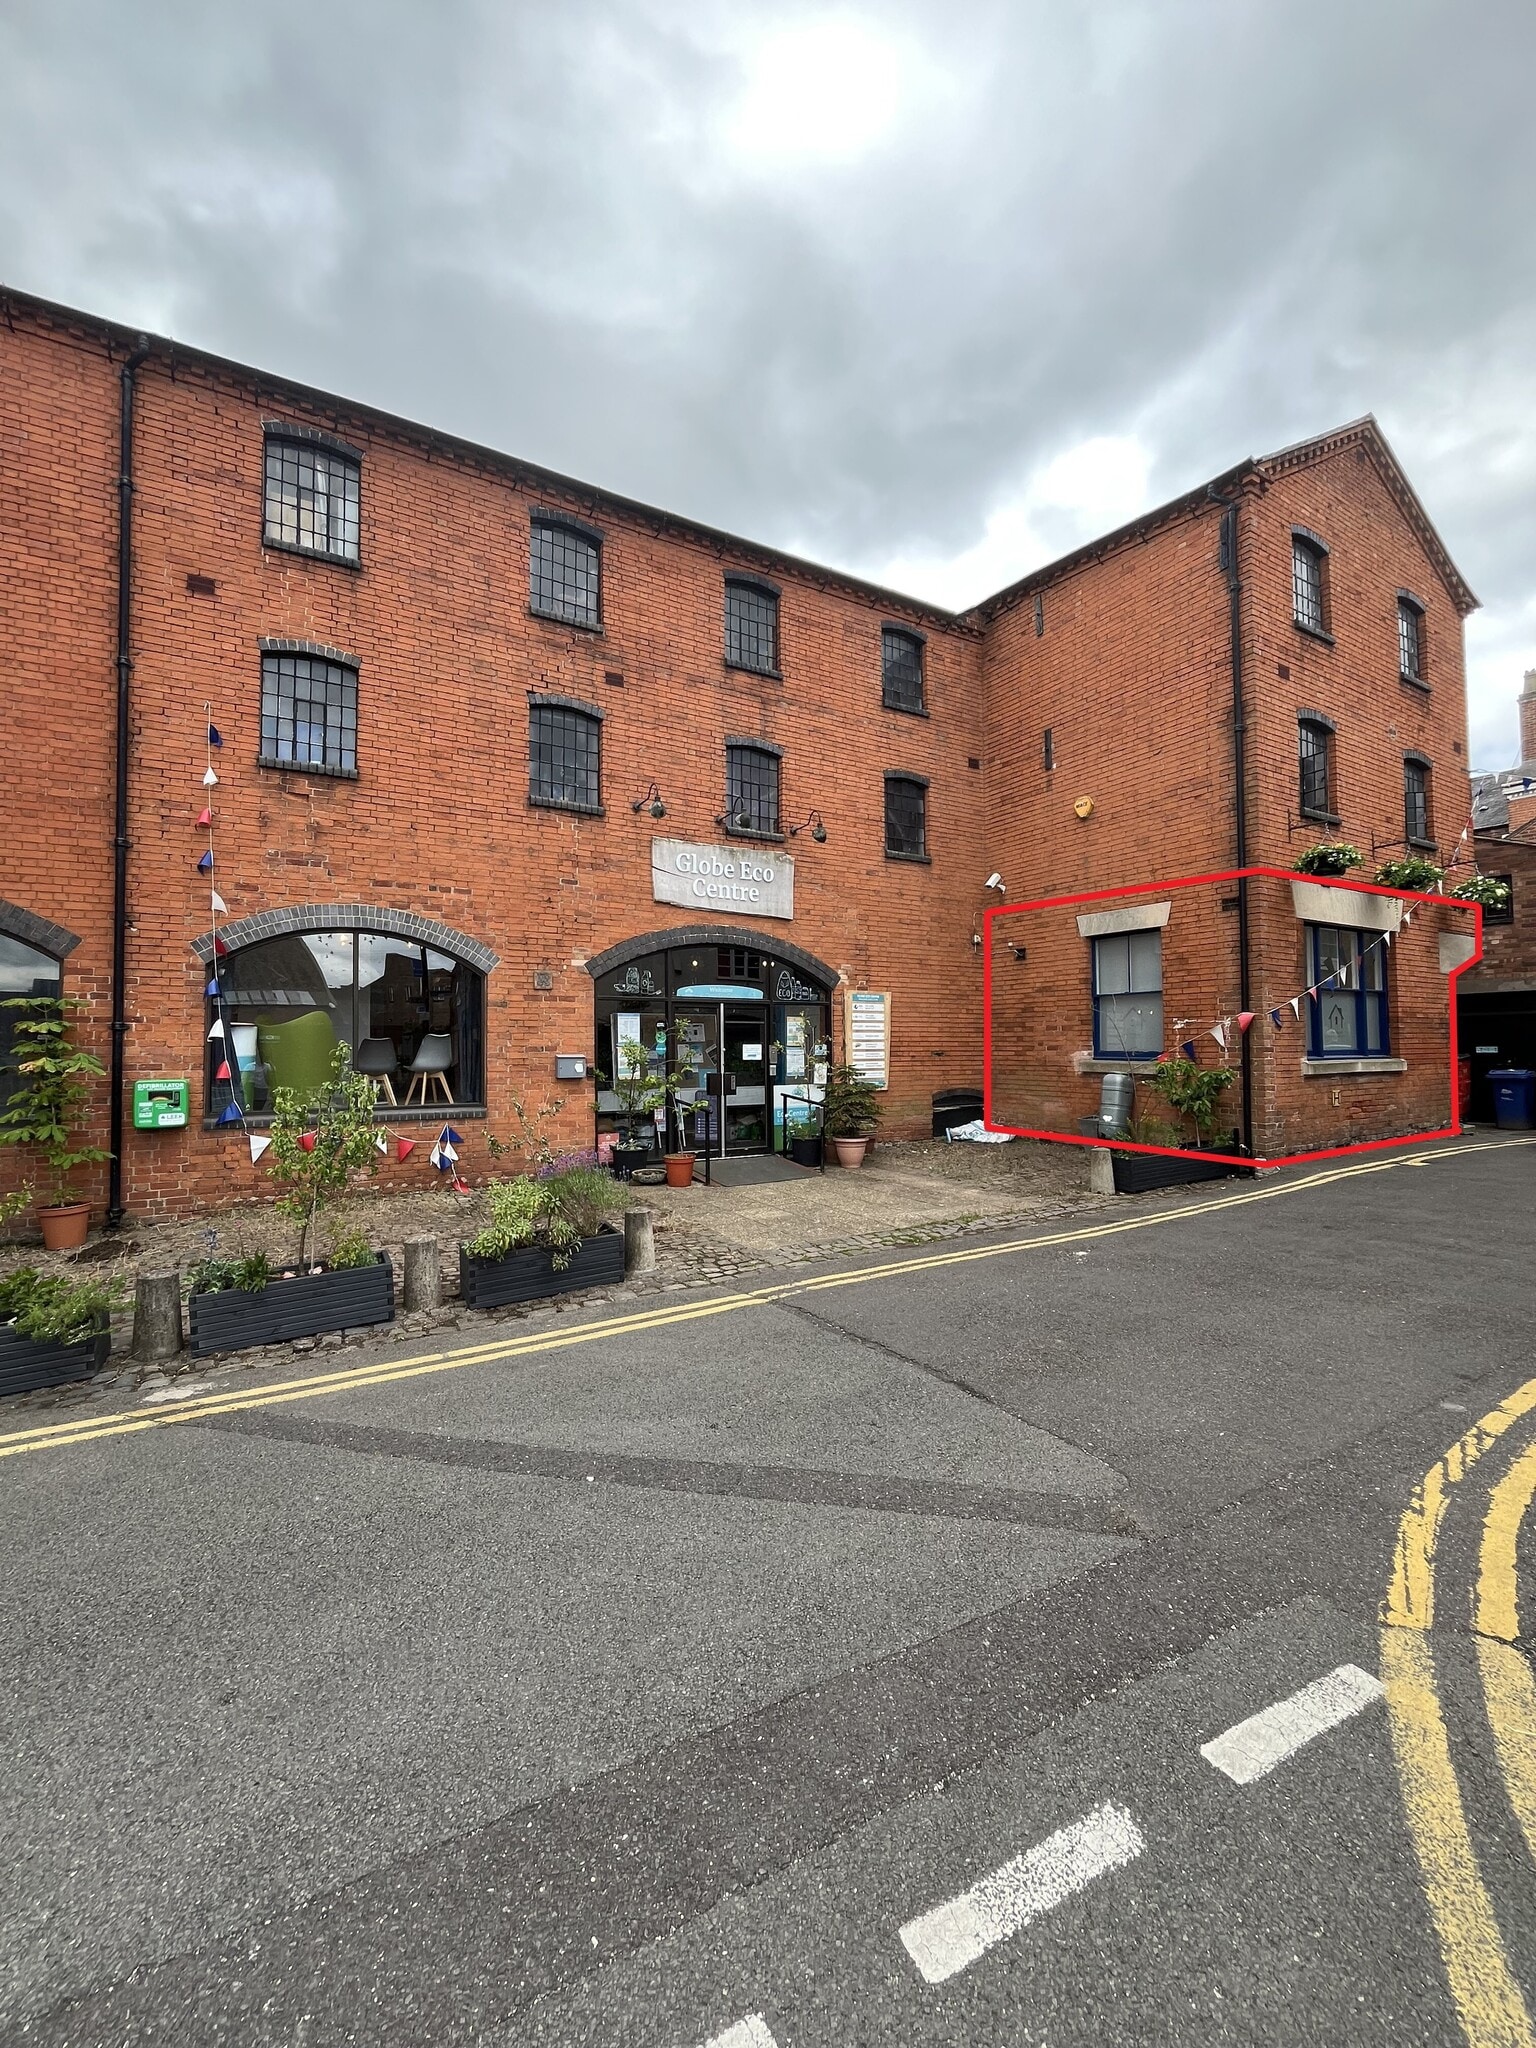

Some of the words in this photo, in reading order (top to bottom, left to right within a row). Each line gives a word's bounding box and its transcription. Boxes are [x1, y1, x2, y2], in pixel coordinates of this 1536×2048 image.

[675, 853, 735, 879] Globe
[740, 861, 775, 883] Eco
[692, 878, 760, 902] Centre
[778, 989, 791, 997] ECO
